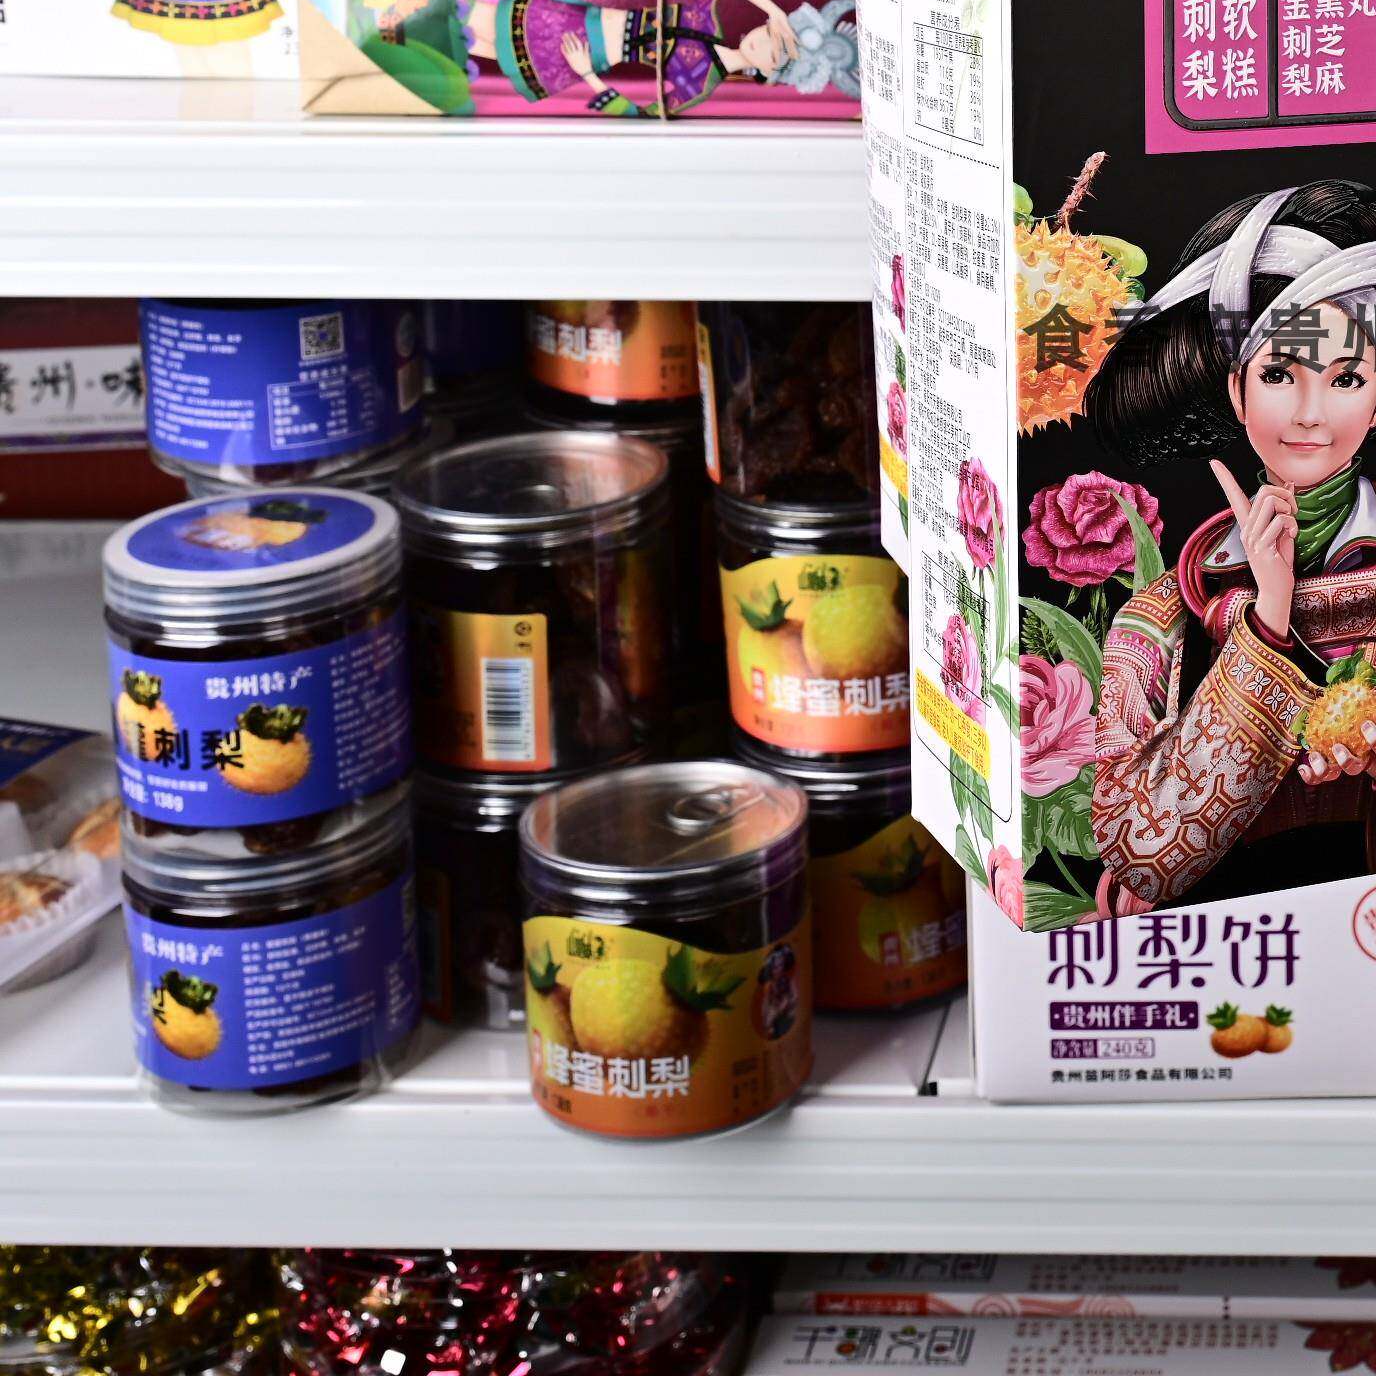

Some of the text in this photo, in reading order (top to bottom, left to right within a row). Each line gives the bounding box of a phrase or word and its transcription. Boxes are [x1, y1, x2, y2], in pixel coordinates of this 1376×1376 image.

[205, 665, 313, 701] 贵州特产
[1047, 913, 1301, 990] 刺梨饼
[1063, 1003, 1190, 1029] 贵州伴手礼
[543, 1041, 691, 1100] 蜂蜜刺梨
[1051, 1067, 1233, 1083] 贵州苗阿莎食品有限公司
